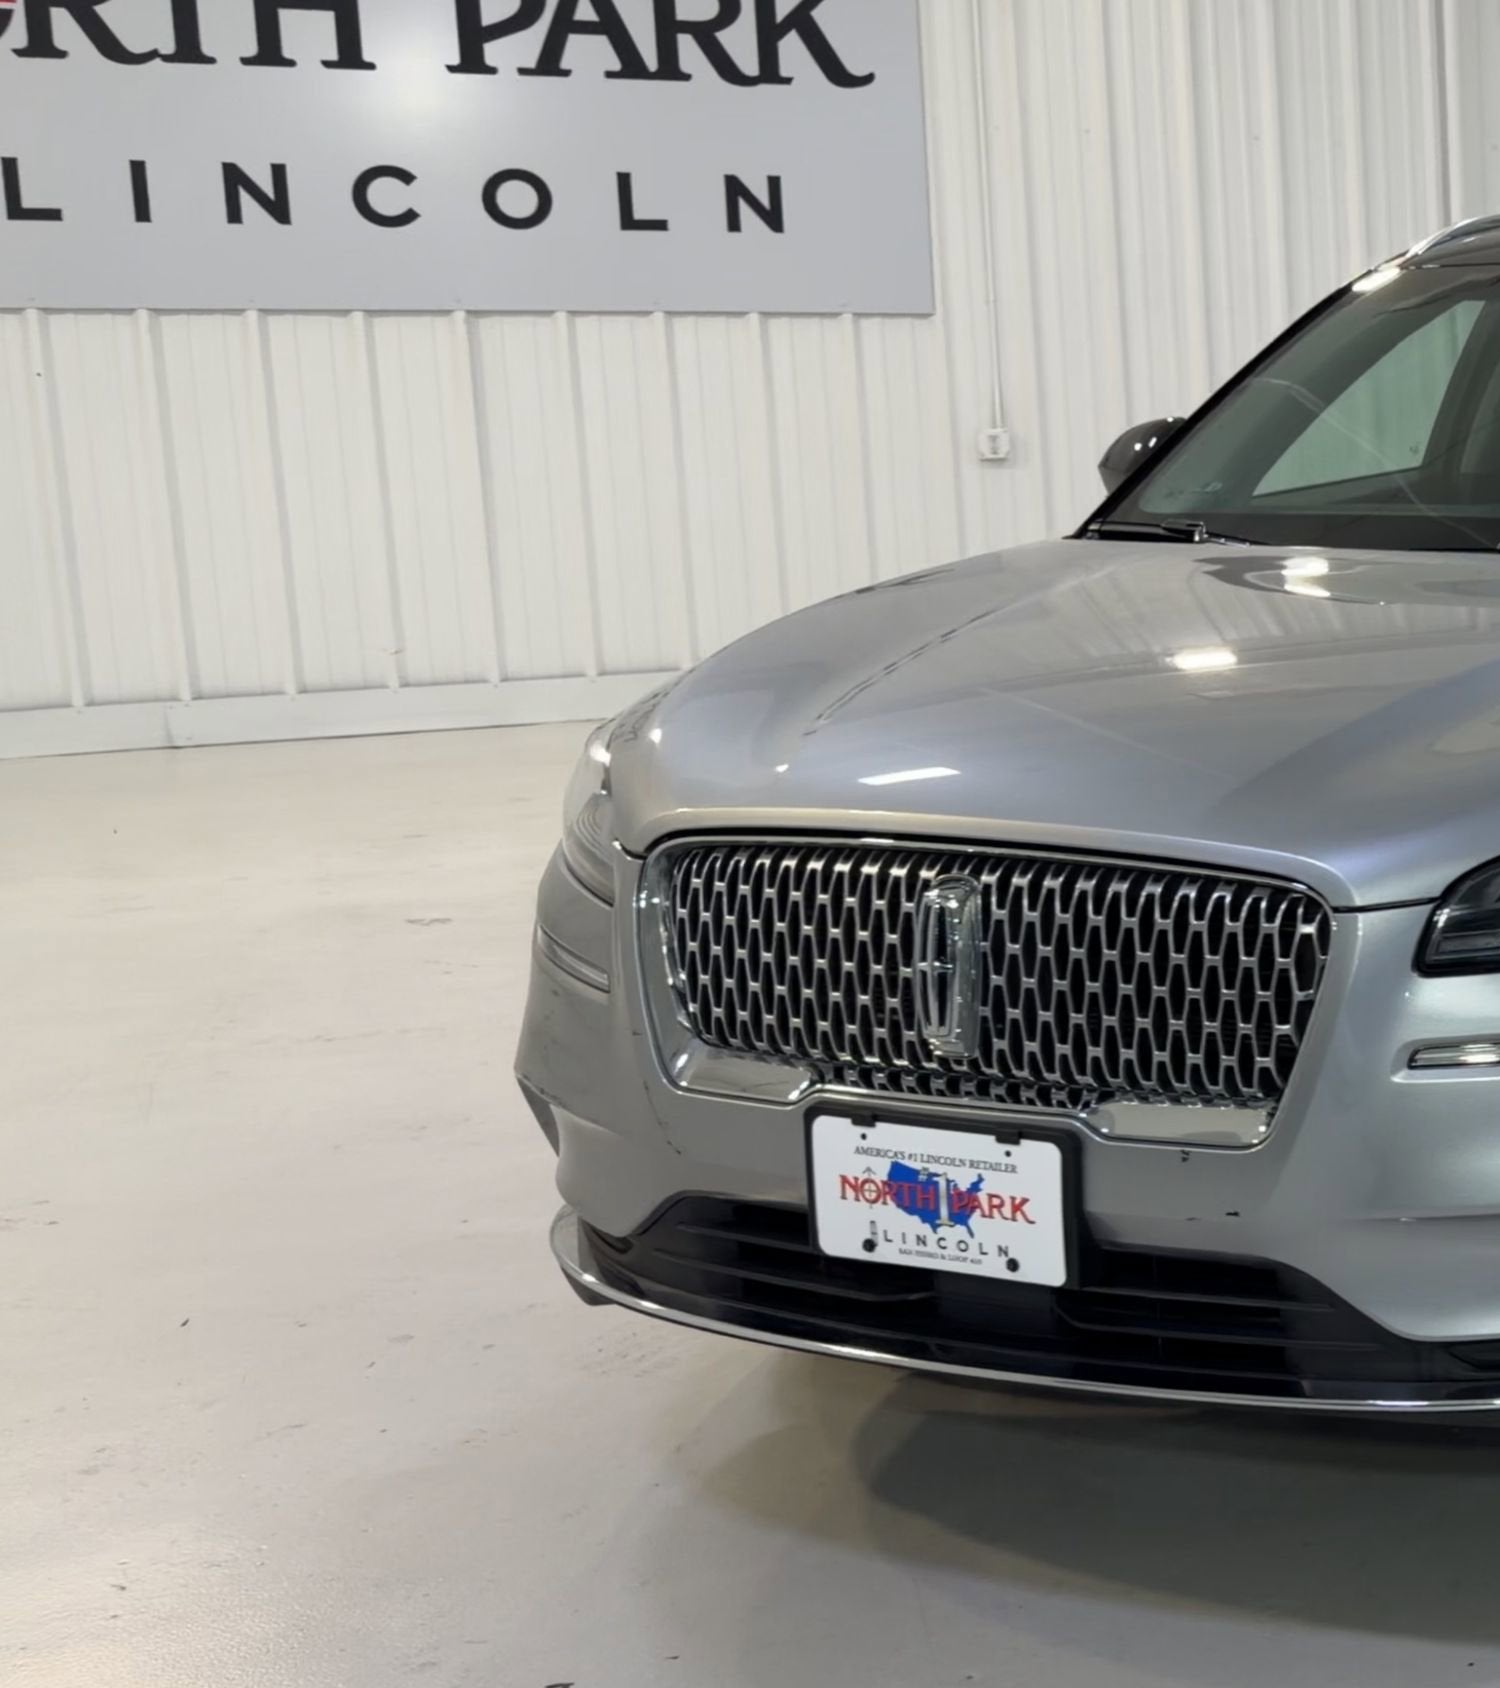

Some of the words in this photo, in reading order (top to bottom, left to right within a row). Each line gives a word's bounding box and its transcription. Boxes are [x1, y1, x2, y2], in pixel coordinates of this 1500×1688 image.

[445, 0, 876, 88] PARK
[1, 156, 785, 235] LINCOLN
[854, 1145, 906, 1161] AMERICA'S
[907, 1153, 918, 1162] #1
[919, 1153, 966, 1168] LINCOLN
[968, 1159, 1018, 1174] RETAILER
[839, 1174, 936, 1211] NORTH
[952, 1188, 1036, 1224] PARK
[883, 1229, 1009, 1258] LINCOLN
